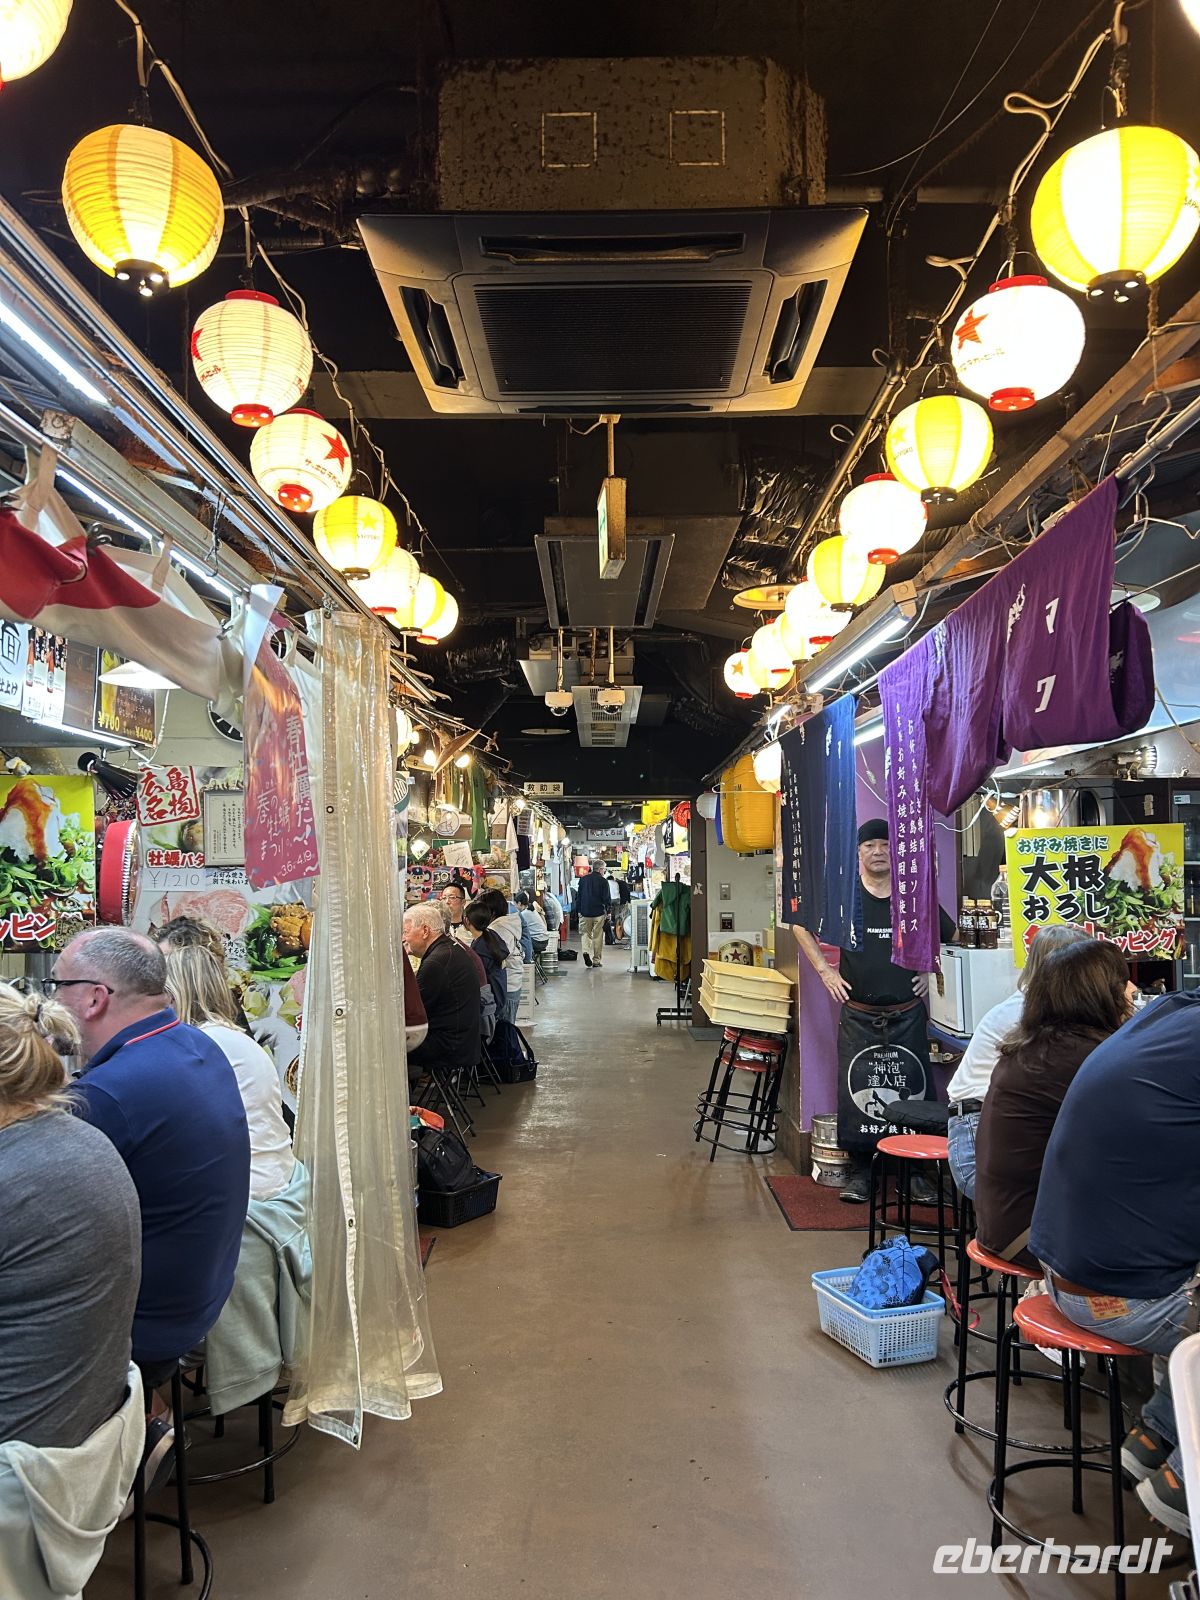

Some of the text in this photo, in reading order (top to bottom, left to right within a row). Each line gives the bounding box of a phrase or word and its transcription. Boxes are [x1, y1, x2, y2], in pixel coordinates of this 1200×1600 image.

[97, 710, 120, 732] ¥700
[1018, 837, 1109, 853] お好み焼きに
[1021, 855, 1104, 893] 大根
[1023, 892, 1110, 920] おろし
[873, 1051, 899, 1059] PREMIUM
[867, 1074, 907, 1088] 達人店
